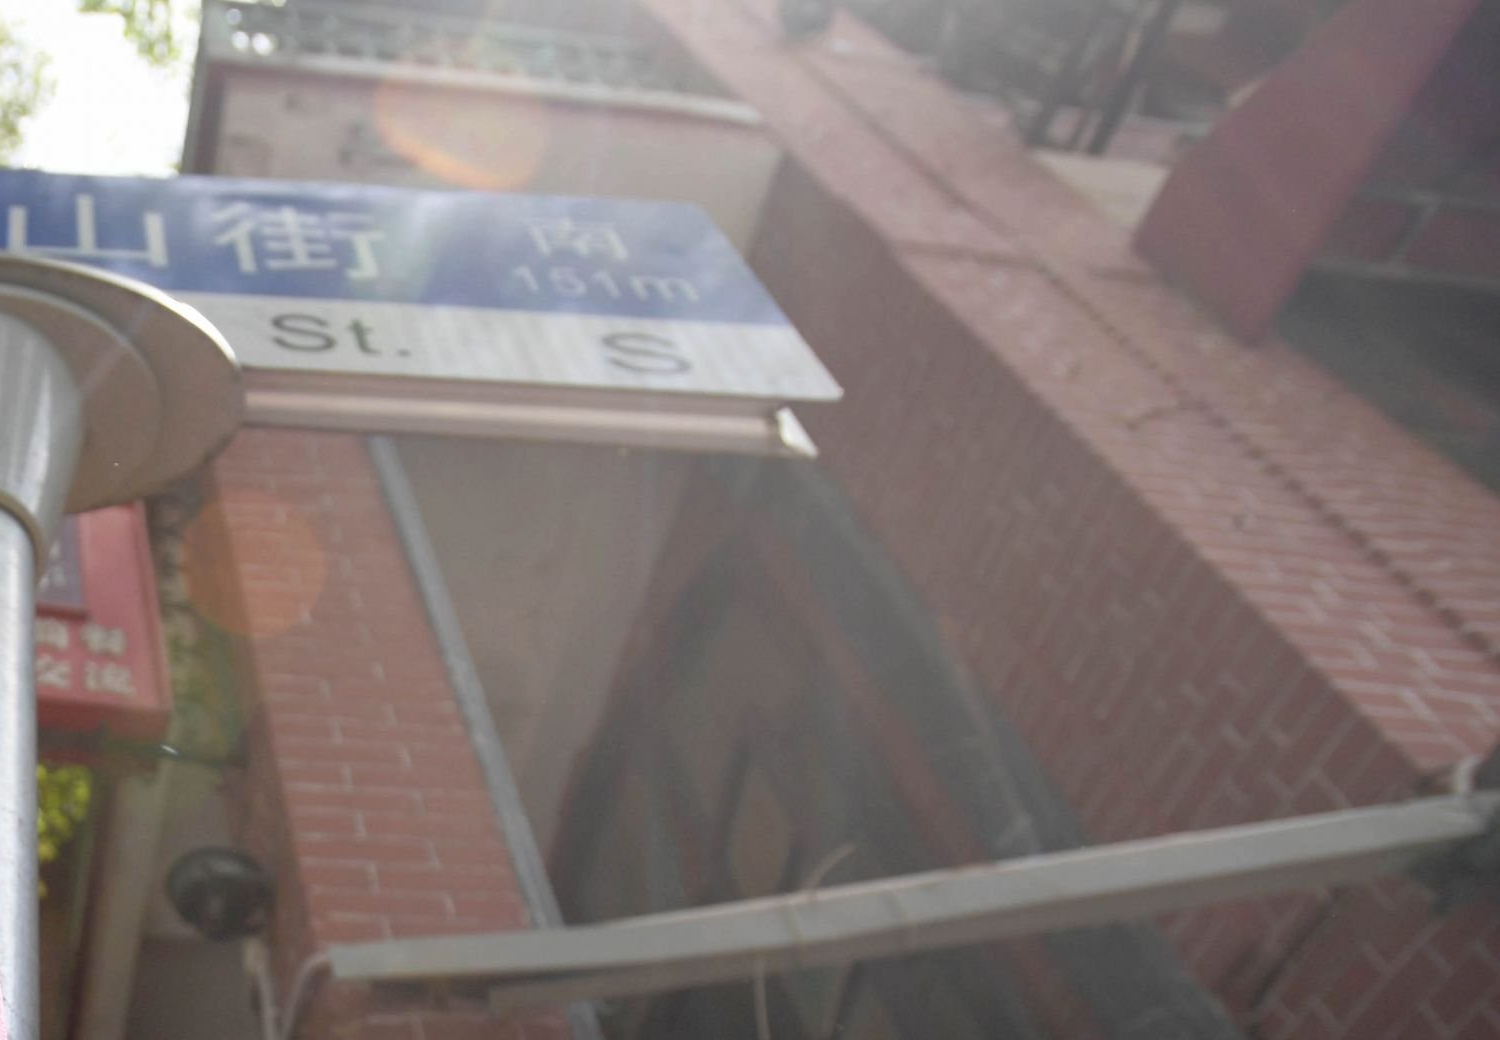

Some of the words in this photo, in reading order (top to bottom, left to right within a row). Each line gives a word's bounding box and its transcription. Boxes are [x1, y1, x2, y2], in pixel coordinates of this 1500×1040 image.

[523, 216, 628, 262] 南
[512, 264, 699, 302] 151m
[270, 313, 412, 356] St.
[601, 332, 692, 375] S
